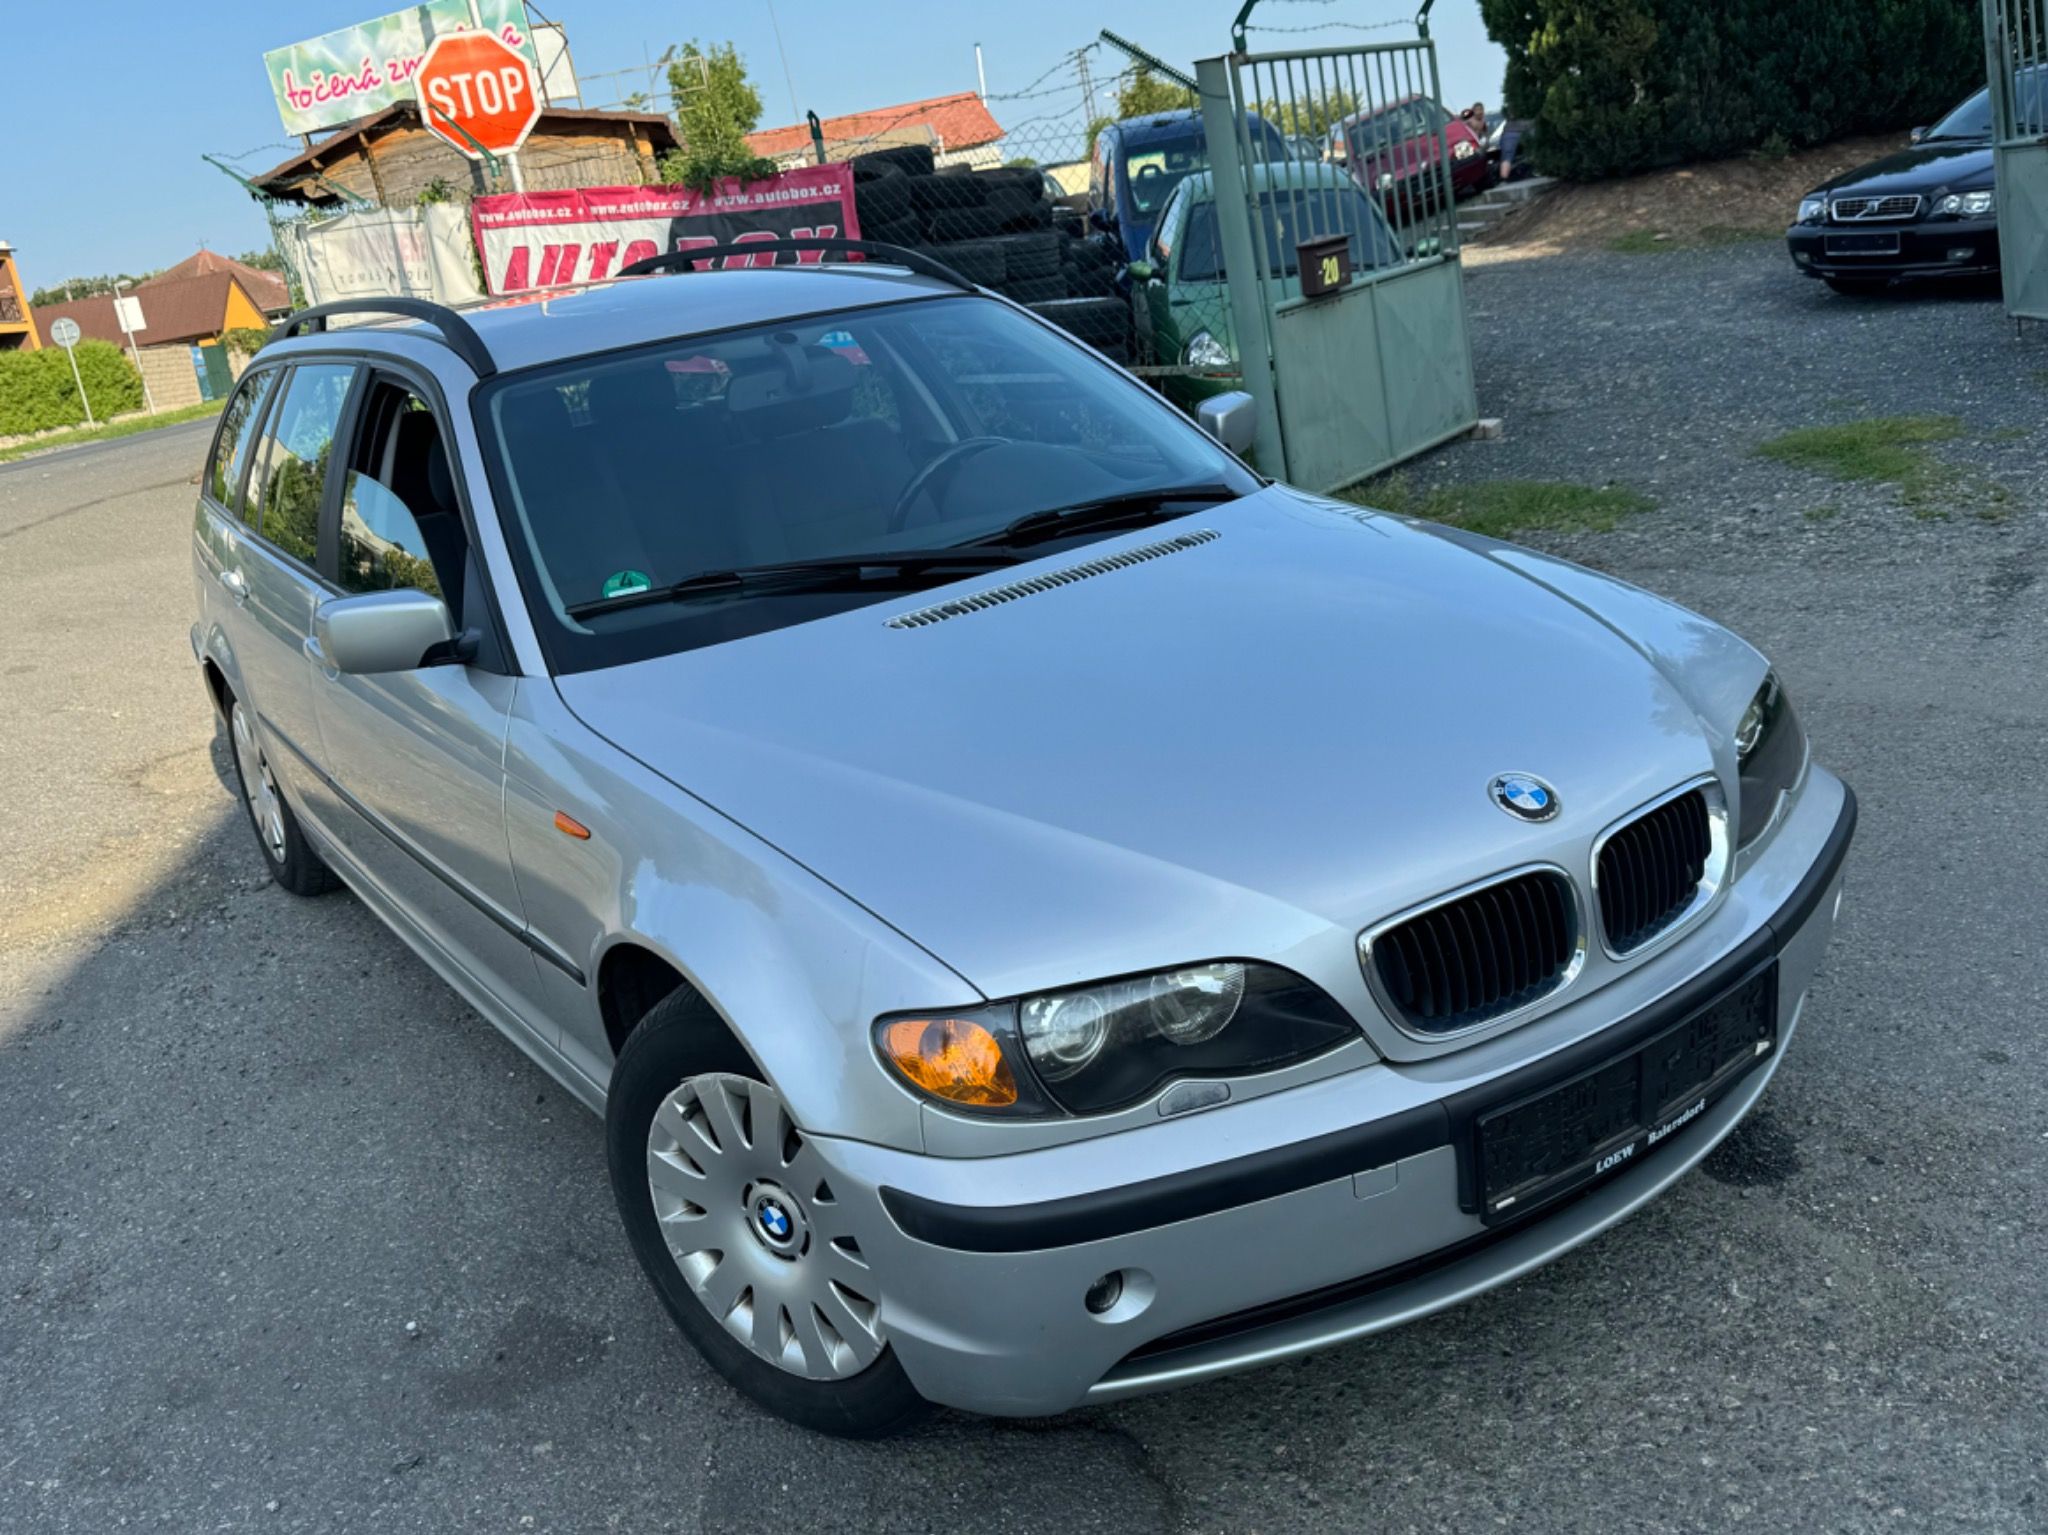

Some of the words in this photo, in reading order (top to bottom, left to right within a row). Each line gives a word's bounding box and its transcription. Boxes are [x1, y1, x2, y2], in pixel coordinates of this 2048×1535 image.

[285, 57, 381, 108] točená
[428, 66, 525, 123] STOP
[478, 207, 573, 223] www.autobox.cz
[590, 199, 690, 216] www.autobox.cz
[714, 184, 842, 207] www.autobox.cz
[1322, 256, 1340, 287] 20
[1595, 1142, 1636, 1175] LOEW
